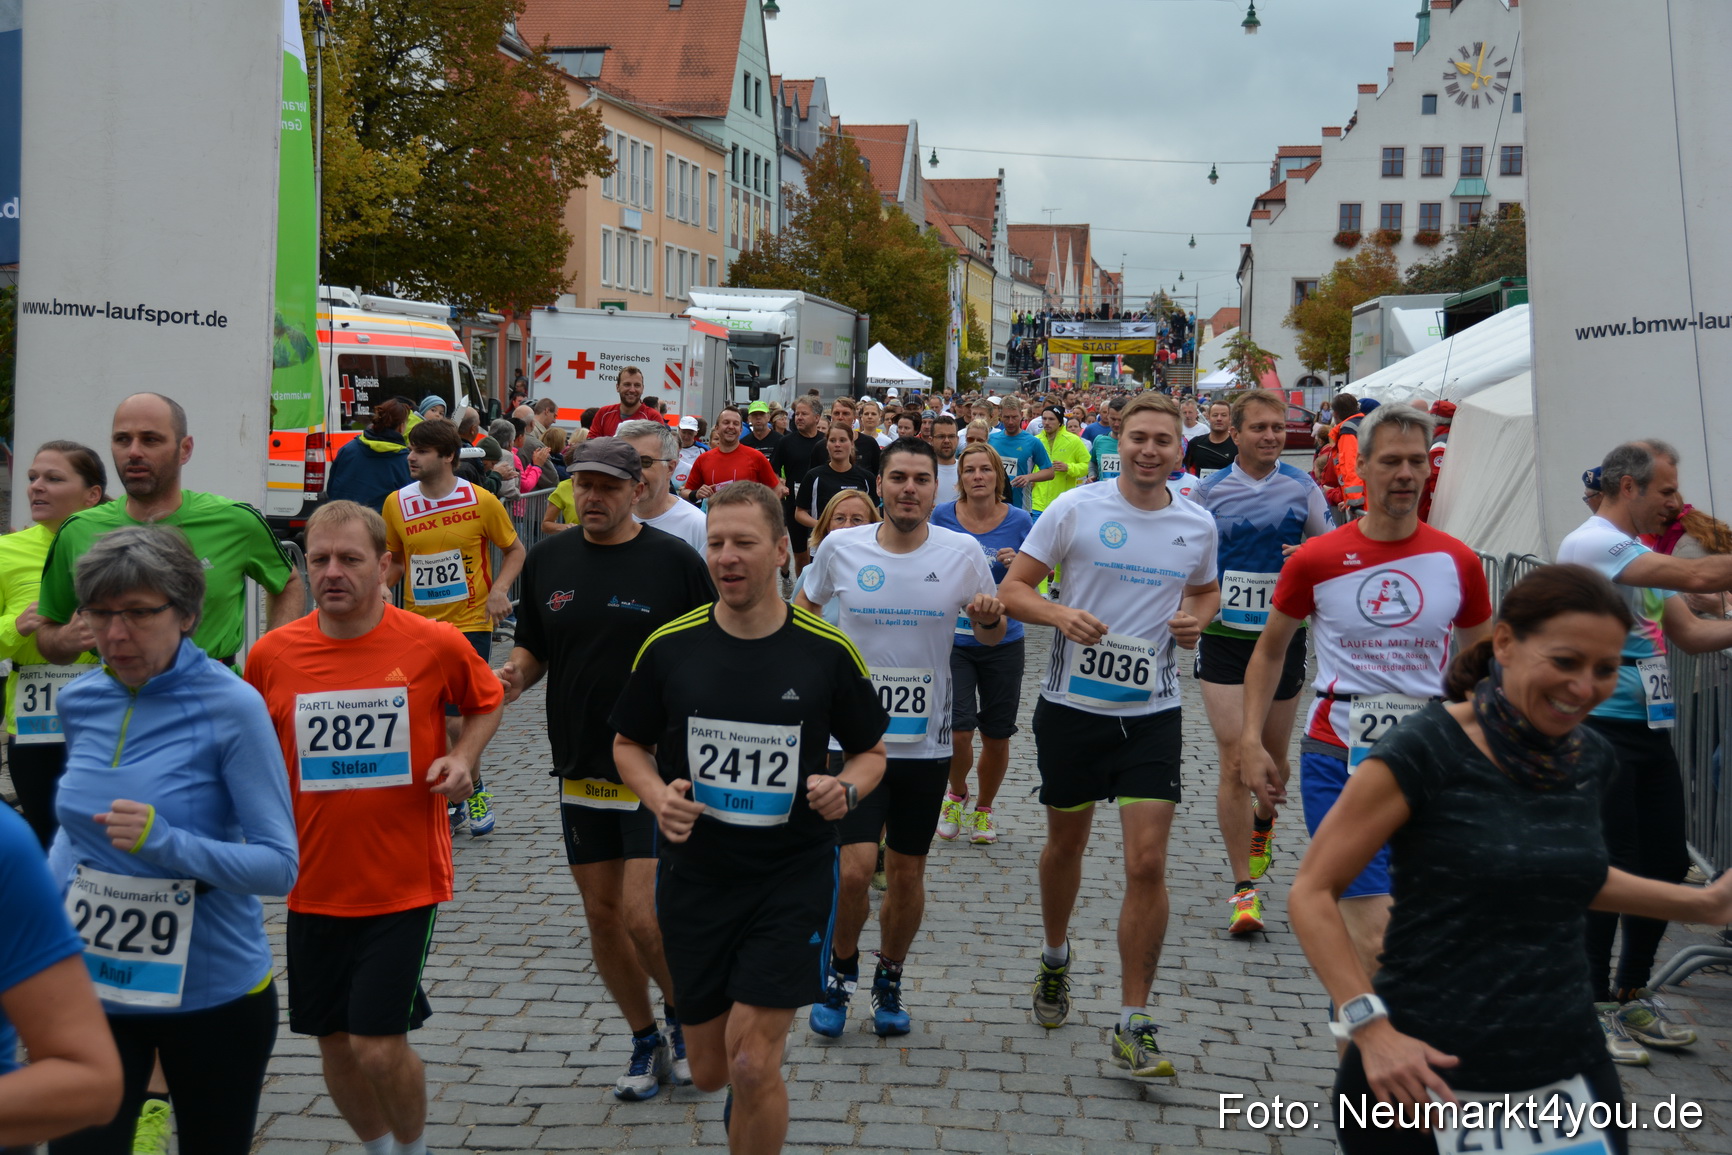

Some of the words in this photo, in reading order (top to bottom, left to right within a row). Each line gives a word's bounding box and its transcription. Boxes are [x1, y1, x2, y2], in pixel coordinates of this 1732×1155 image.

[22, 298, 228, 328] www.bmw-laufsport.de
[1574, 312, 1732, 340] www.bmw-lau
[1082, 342, 1119, 352] START
[600, 352, 650, 364] Bayerisches
[600, 363, 623, 372] Rotes
[598, 374, 619, 382] Kreu
[870, 377, 904, 385] Laufsport
[1004, 463, 1015, 474] 77
[406, 520, 438, 536] MAX
[442, 510, 480, 526] BÖGL
[425, 556, 452, 565] Neumarkt
[416, 563, 460, 586] 2782
[1130, 576, 1145, 584] April
[428, 589, 450, 598] Marco
[1228, 586, 1273, 608] 211
[1244, 613, 1261, 624] Sigi
[1106, 640, 1145, 654] Neumarkt
[1340, 638, 1382, 648] LAUFEN
[1388, 639, 1409, 647] MIT
[1080, 648, 1150, 686] 3036
[23, 683, 64, 712] 31
[298, 701, 334, 711] PARTL
[337, 699, 388, 709] Neumarkt
[878, 686, 926, 714] 028
[308, 713, 398, 752] 2827
[691, 727, 726, 740] PARTL
[729, 732, 781, 745] Neumarkt
[332, 760, 377, 775] Stefan
[699, 744, 789, 787] 2412
[586, 784, 618, 797] Stefan
[724, 793, 754, 810] Toni
[74, 877, 102, 895] PARTL
[103, 886, 168, 903] Neumarkt
[75, 899, 179, 955] 2229
[99, 962, 133, 984] Anni
